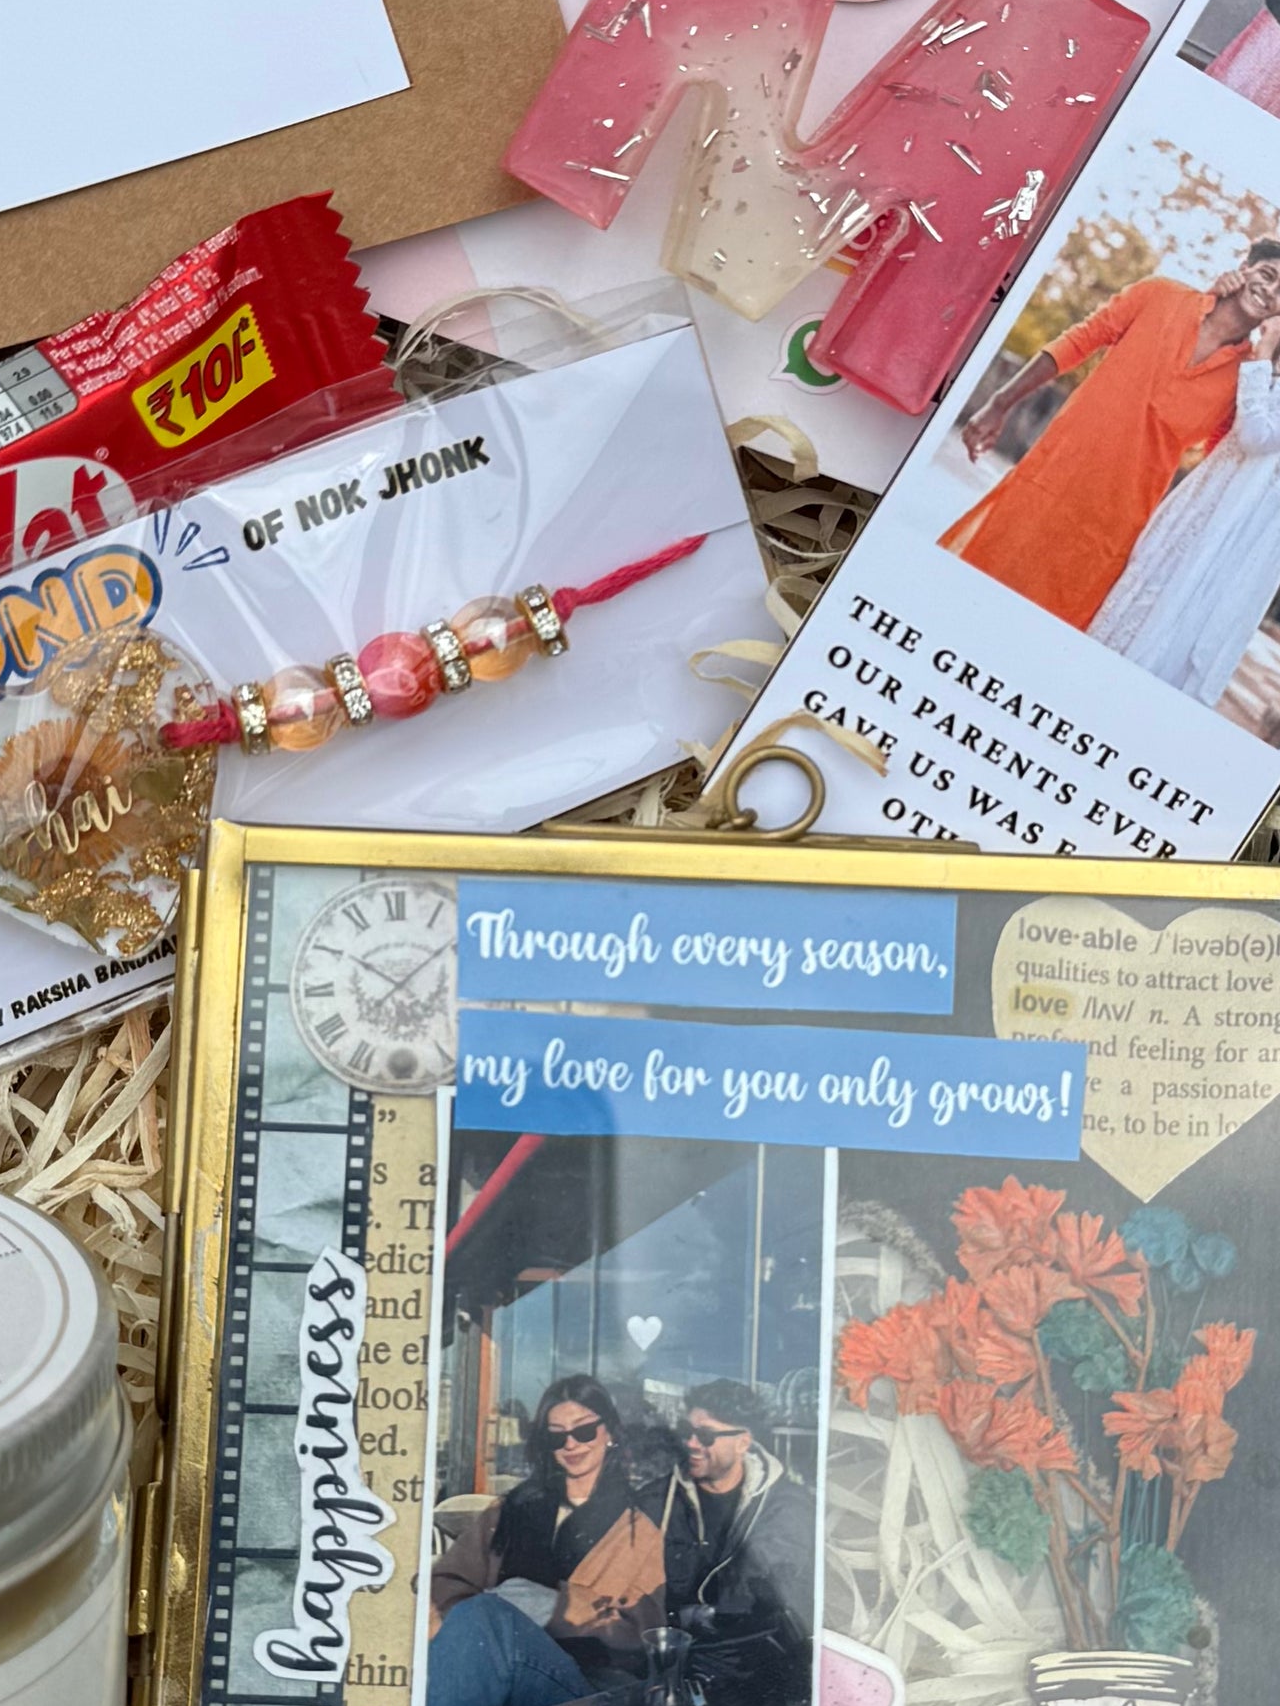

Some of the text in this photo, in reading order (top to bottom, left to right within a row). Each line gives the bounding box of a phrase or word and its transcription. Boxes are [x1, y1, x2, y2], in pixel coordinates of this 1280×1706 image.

[242, 508, 284, 552] OF
[295, 478, 367, 532] NOK
[378, 435, 491, 500] JHONK
[828, 645, 1178, 859] OUR PARENTS EVER
[849, 595, 1214, 826] THE GREATEST GIFT
[803, 689, 1044, 845] GAVE US WAS
[466, 907, 661, 979] Through
[672, 931, 792, 989] every
[801, 932, 950, 980] season,
[1016, 959, 1274, 993] qualities attract love
[10, 972, 92, 1020] RAKSHA
[1012, 986, 1070, 1017] love
[462, 1036, 1074, 1129] my love for you only grows!
[1128, 1035, 1205, 1069] feeling
[1152, 1077, 1273, 1105] passionate
[266, 1255, 385, 1673] happiness
